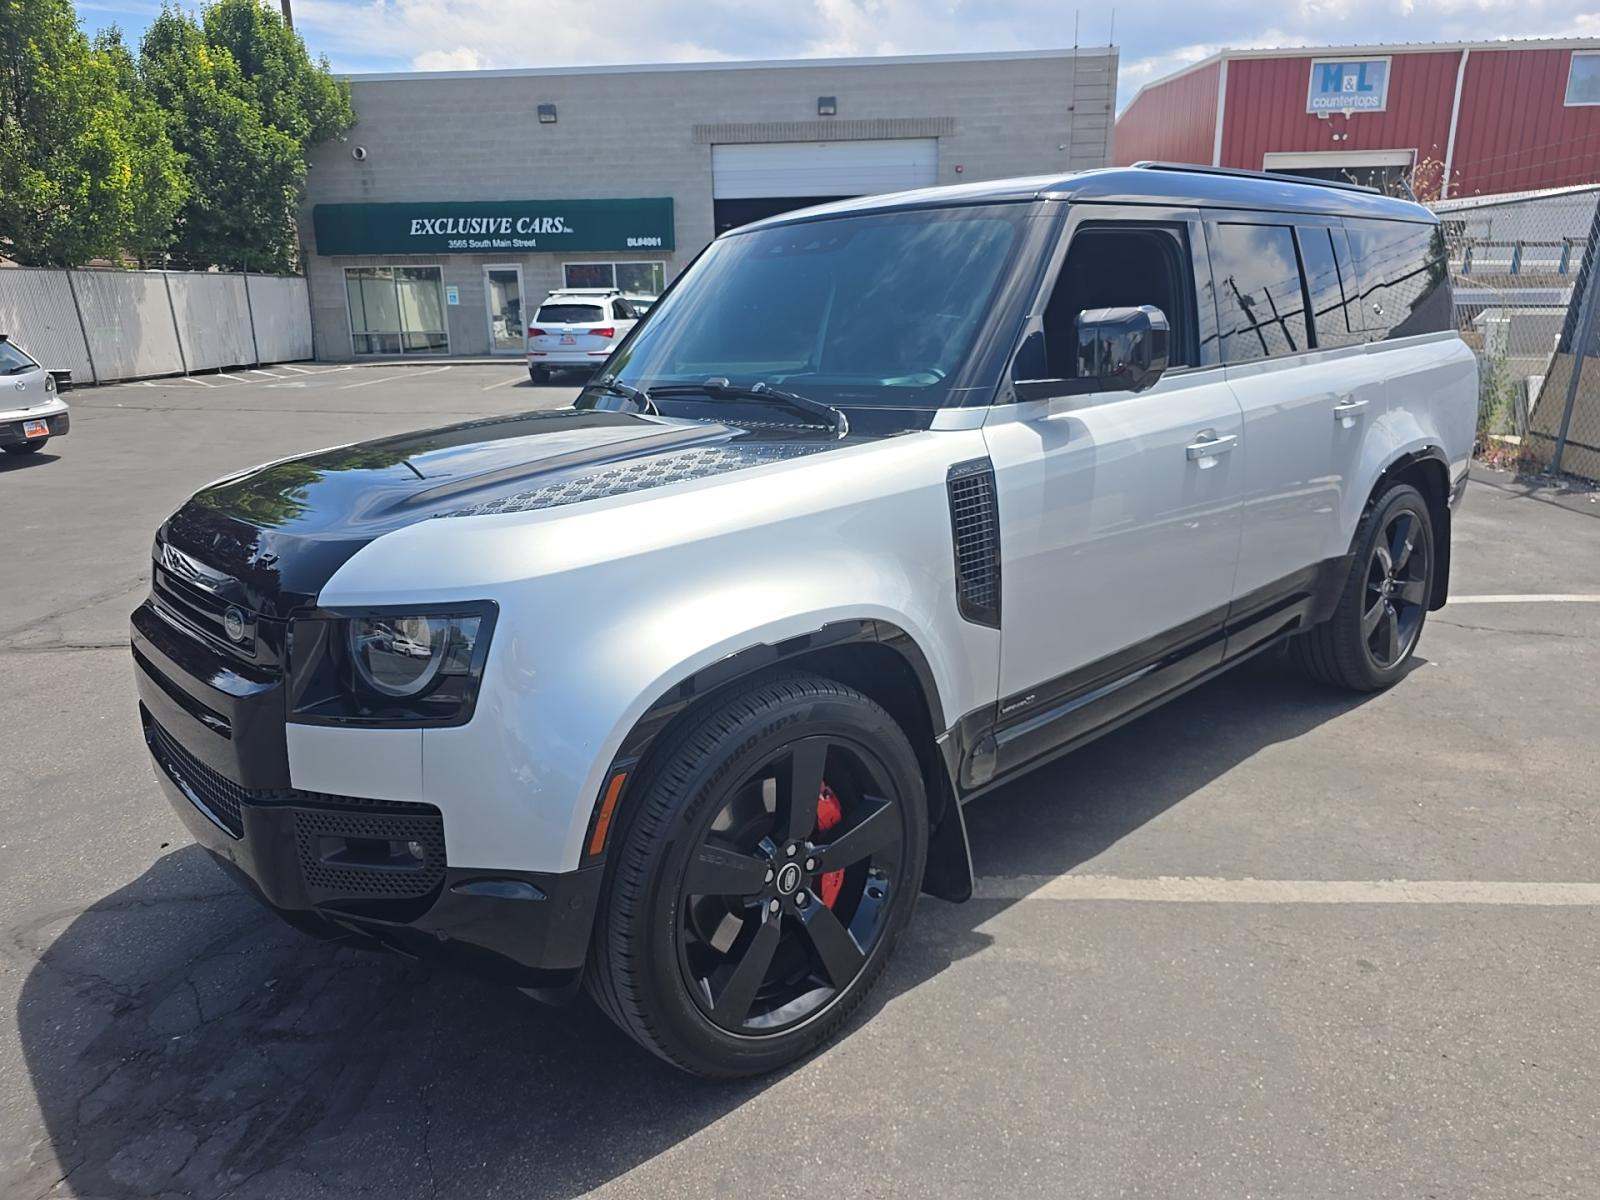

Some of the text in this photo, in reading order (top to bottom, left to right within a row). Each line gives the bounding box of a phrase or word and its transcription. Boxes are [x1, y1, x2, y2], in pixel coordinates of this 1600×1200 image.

[1313, 96, 1378, 109] countertops
[410, 217, 512, 235] EXCLUSIVE
[516, 216, 564, 234] CARS
[468, 239, 491, 248] South
[492, 238, 511, 248] Main
[512, 238, 536, 248] Street
